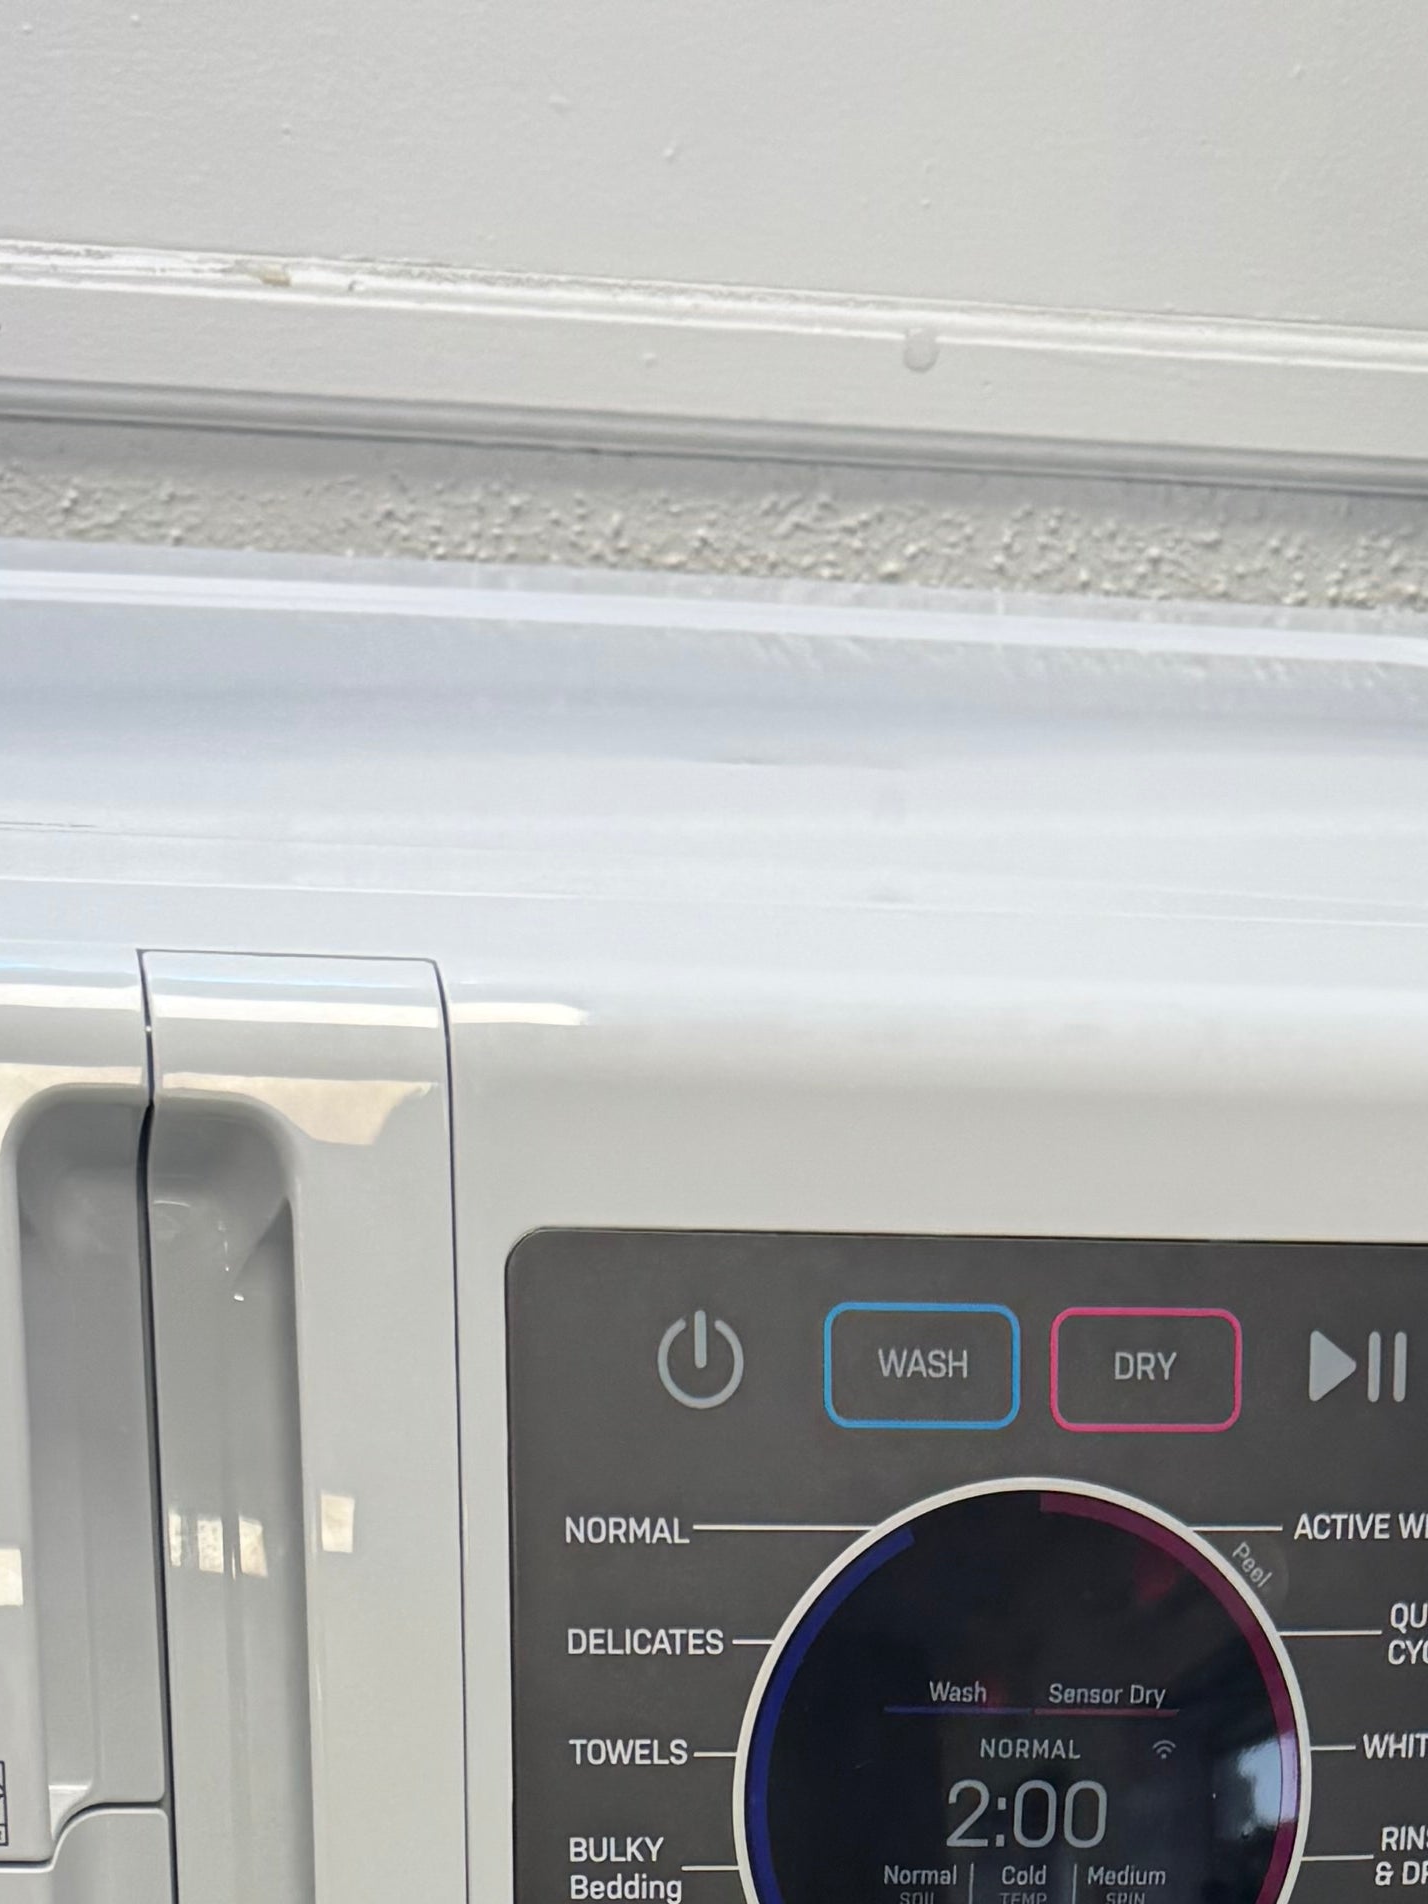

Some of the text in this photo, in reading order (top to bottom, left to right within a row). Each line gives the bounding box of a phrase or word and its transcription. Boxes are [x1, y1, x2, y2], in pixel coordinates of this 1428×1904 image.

[877, 1348, 969, 1379] WASH
[1113, 1351, 1177, 1381] DRY
[564, 1515, 690, 1545] NORMAL
[1292, 1511, 1391, 1541] ACTIVE
[1231, 1540, 1273, 1590] Peel
[567, 1627, 725, 1656] DELICATES
[929, 1680, 988, 1704] Wash
[1048, 1682, 1167, 1710] Sensor Dry
[568, 1738, 689, 1766] TOWELS
[979, 1737, 1082, 1760] NORMAL
[945, 1778, 1109, 1849] 2:00
[568, 1835, 664, 1863] BULKY
[882, 1863, 958, 1886] Normal
[1001, 1864, 1047, 1886] Cold
[1086, 1865, 1167, 1887] Medium
[1374, 1861, 1395, 1886] &
